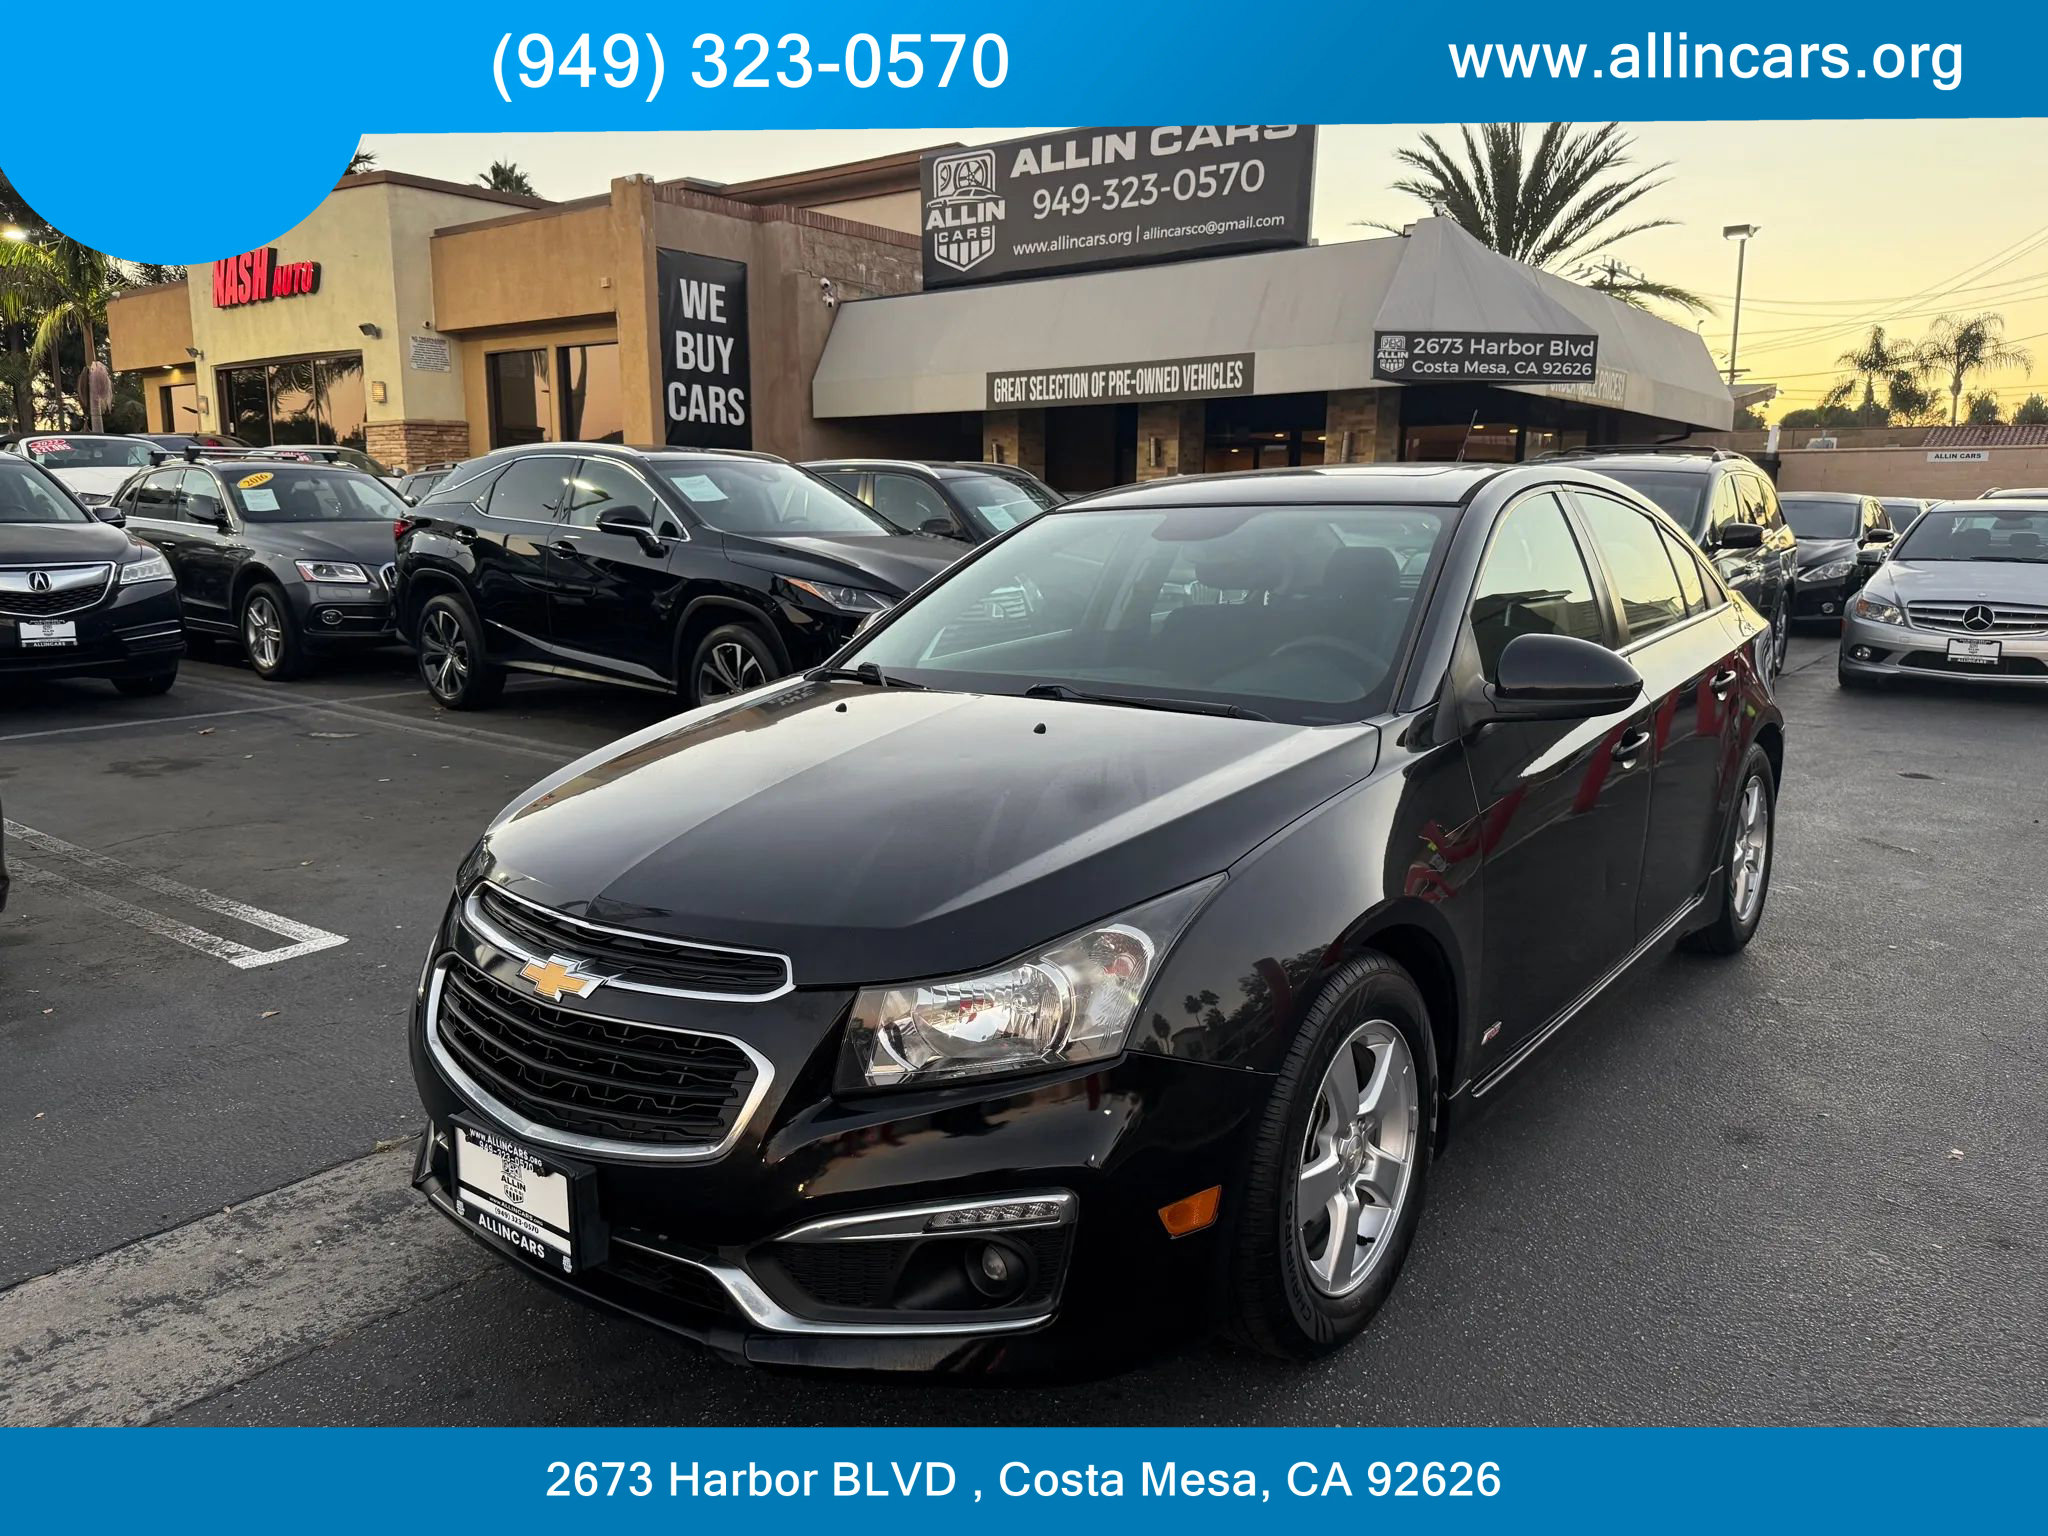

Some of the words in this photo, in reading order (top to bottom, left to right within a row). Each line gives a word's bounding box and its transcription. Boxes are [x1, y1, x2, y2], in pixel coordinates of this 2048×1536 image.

[1010, 131, 1136, 178] ALLIN
[1033, 159, 1265, 220] 949-323-0570
[926, 200, 1006, 230] ALLIN
[1143, 214, 1285, 240] allincarsco@gmail.com
[938, 227, 991, 243] CARS
[1013, 229, 1132, 256] www.allincars.org
[213, 247, 269, 308] NASH
[272, 260, 314, 297] AUTO
[680, 278, 727, 324] WE
[676, 330, 735, 375] BUY
[1377, 351, 1409, 359] ALLIN
[1413, 338, 1463, 354] 2673
[1470, 339, 1544, 356] Harbor
[1550, 340, 1595, 357] Blvd
[994, 377, 1028, 403] GREAT
[1029, 371, 1089, 401] SELECTION
[1091, 371, 1106, 397] OF
[1108, 365, 1180, 397] PRE-OWNED
[1182, 360, 1244, 392] VEHICLES
[1412, 360, 1459, 374] Costa
[1464, 361, 1511, 376] Mesa,
[1514, 362, 1539, 375] CA
[1542, 362, 1592, 376] 92626
[668, 381, 745, 426] CARS
[243, 473, 269, 487] 2016
[501, 1174, 527, 1192] ALLIN
[478, 1213, 546, 1259] ALLINCARS
